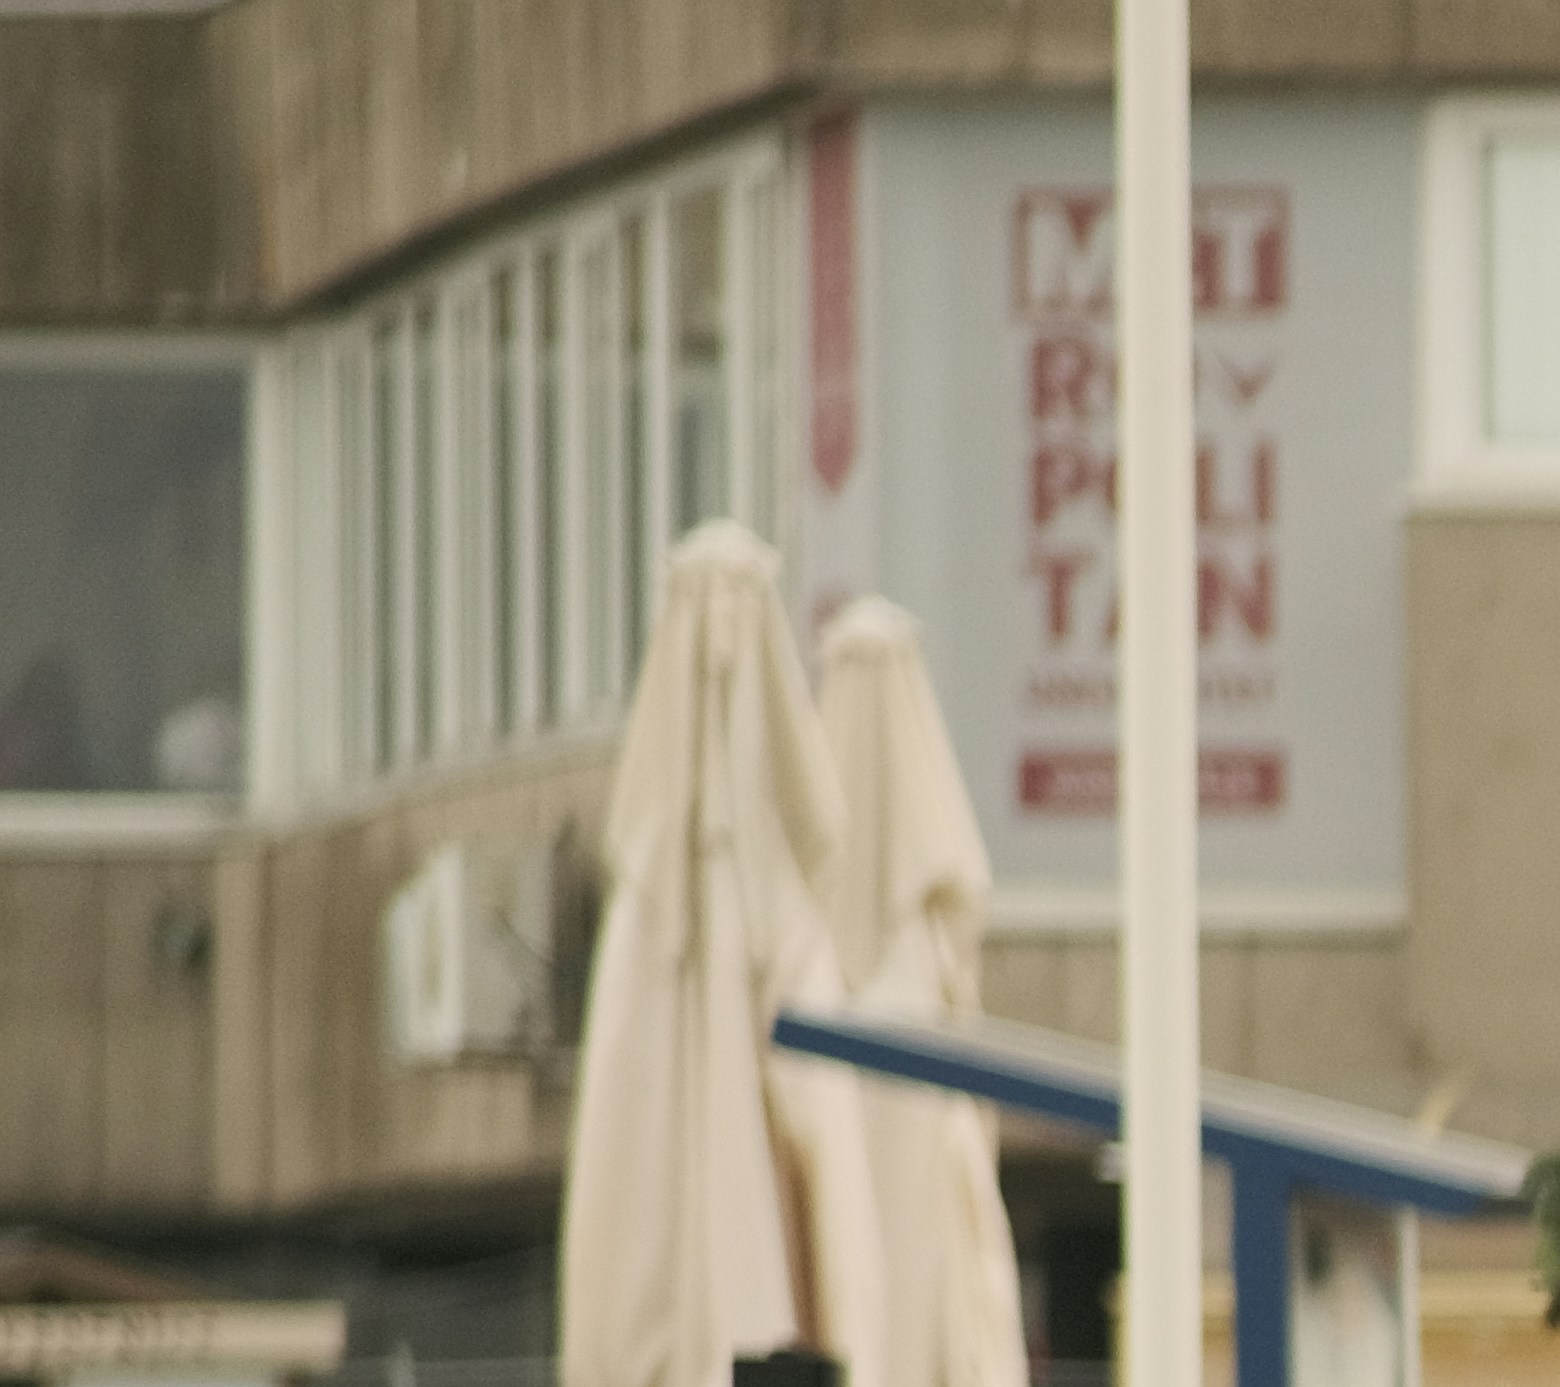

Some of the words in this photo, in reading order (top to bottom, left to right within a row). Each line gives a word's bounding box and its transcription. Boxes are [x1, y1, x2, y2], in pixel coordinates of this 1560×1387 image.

[1024, 198, 1280, 308] MT
[1028, 443, 1276, 530] PLI
[1026, 553, 1276, 648] TN
